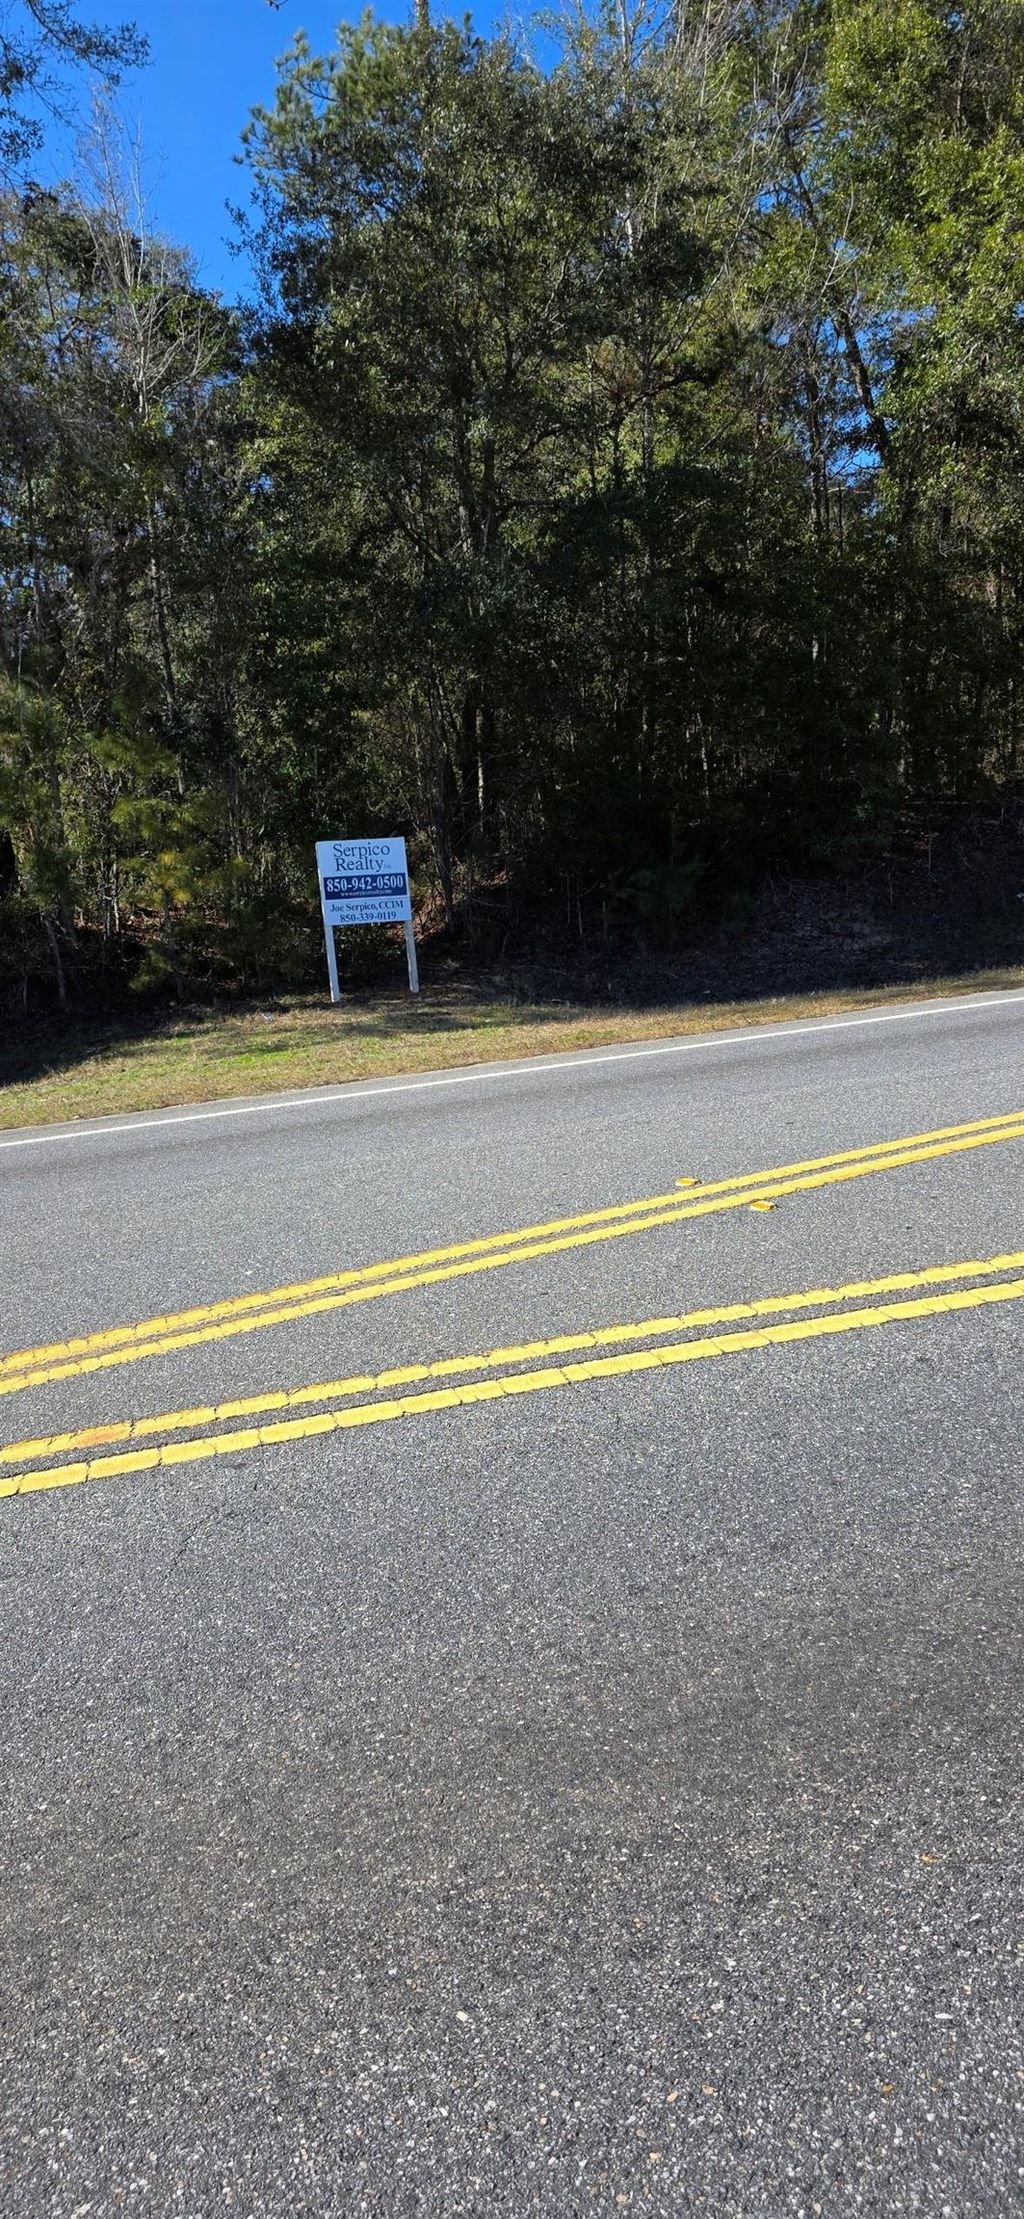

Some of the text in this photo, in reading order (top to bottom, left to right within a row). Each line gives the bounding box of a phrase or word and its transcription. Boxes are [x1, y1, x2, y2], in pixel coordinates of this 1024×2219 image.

[333, 842, 390, 859] Serpico
[335, 857, 384, 872] Realty
[326, 875, 404, 892] 850-942-0500
[330, 900, 404, 912] Joe Serpico, CCIM
[340, 911, 396, 922] 850-339-0119
